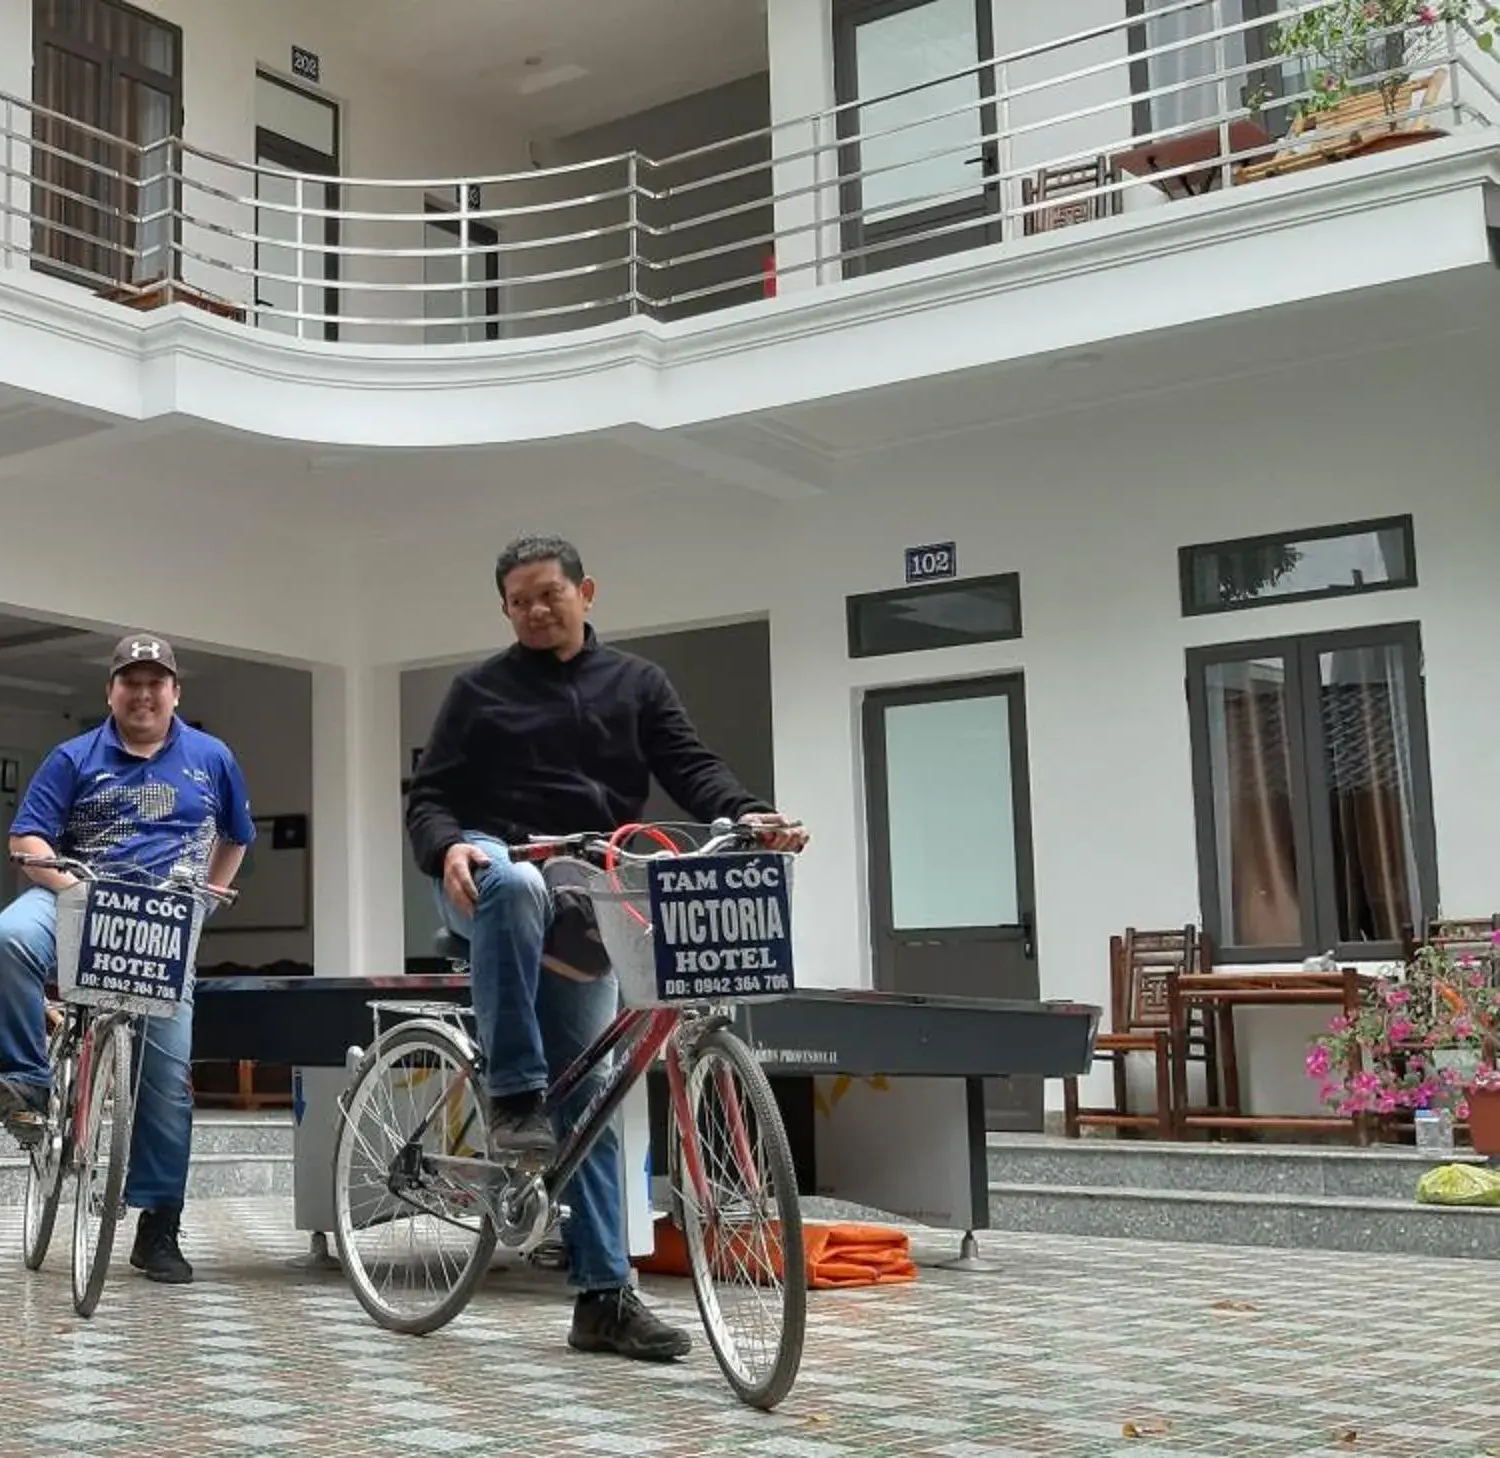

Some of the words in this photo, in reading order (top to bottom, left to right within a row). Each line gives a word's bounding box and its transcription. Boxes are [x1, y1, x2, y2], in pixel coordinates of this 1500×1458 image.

[912, 551, 949, 574] 102
[657, 870, 718, 892] TAM
[725, 858, 779, 889] CỐC
[95, 890, 140, 912] TAM
[146, 895, 187, 920] CỐC
[660, 896, 785, 944] VICTORIA
[90, 912, 182, 961] VICTORIA
[92, 953, 170, 981] HOTEL
[675, 947, 776, 973] HOTEL
[695, 978, 730, 993] 0942
